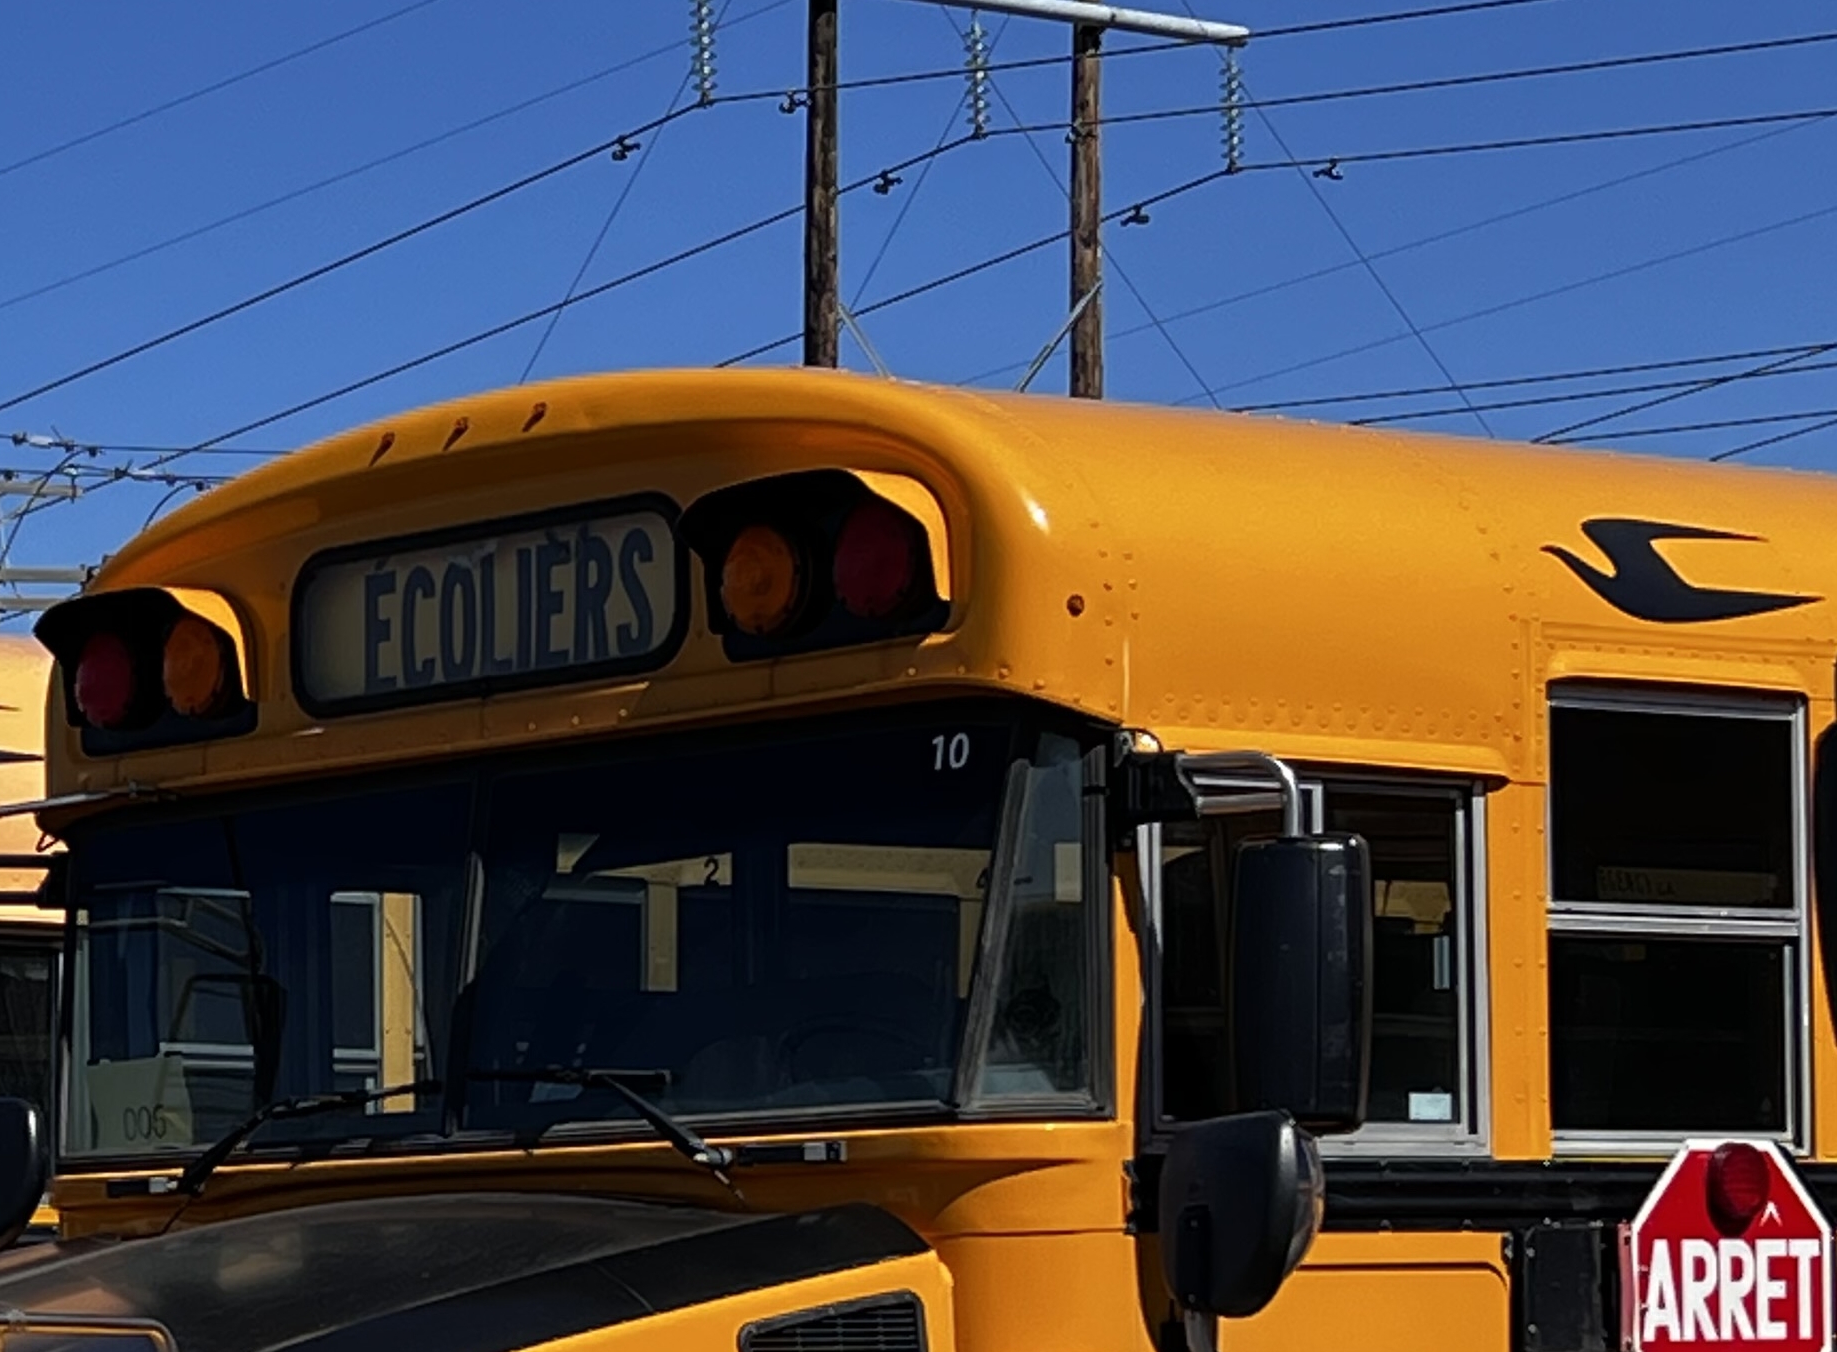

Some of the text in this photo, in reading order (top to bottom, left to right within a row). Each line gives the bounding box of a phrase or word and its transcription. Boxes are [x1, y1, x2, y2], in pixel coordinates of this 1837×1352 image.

[932, 732, 969, 769] 10
[704, 857, 719, 885] 2
[1643, 1201, 1821, 1342] ARRÊT
